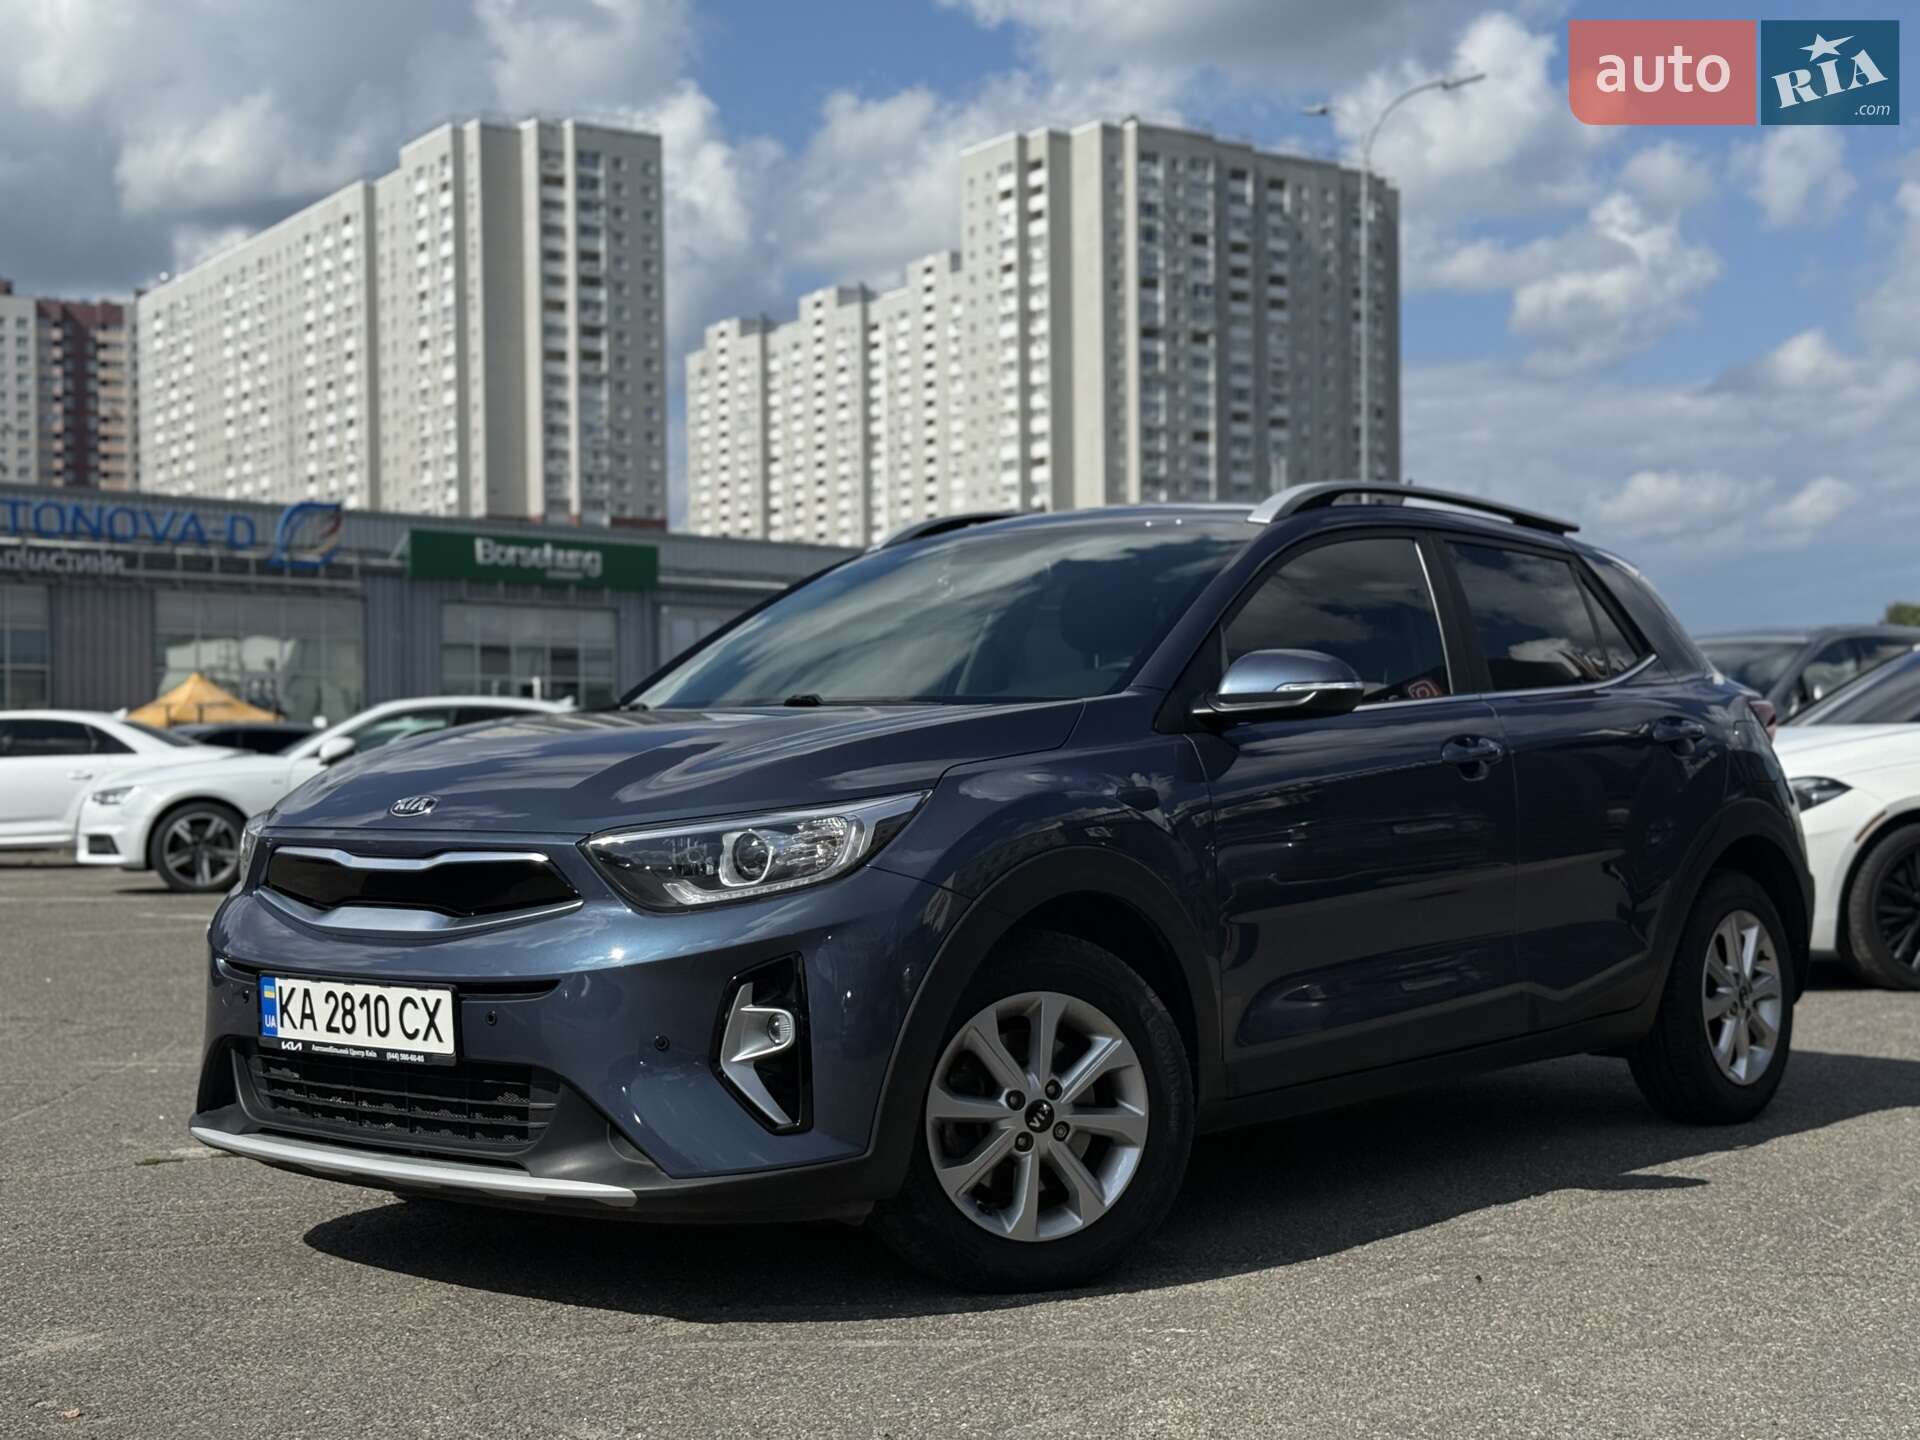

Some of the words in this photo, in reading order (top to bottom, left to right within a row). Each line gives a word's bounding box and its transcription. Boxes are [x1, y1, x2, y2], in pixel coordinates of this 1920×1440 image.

[0, 499, 257, 549] TONOVA-D
[392, 796, 433, 812] KIA
[264, 1014, 277, 1028] UA
[278, 986, 318, 1031] KA
[324, 990, 390, 1038] 2810
[399, 996, 444, 1043] CX
